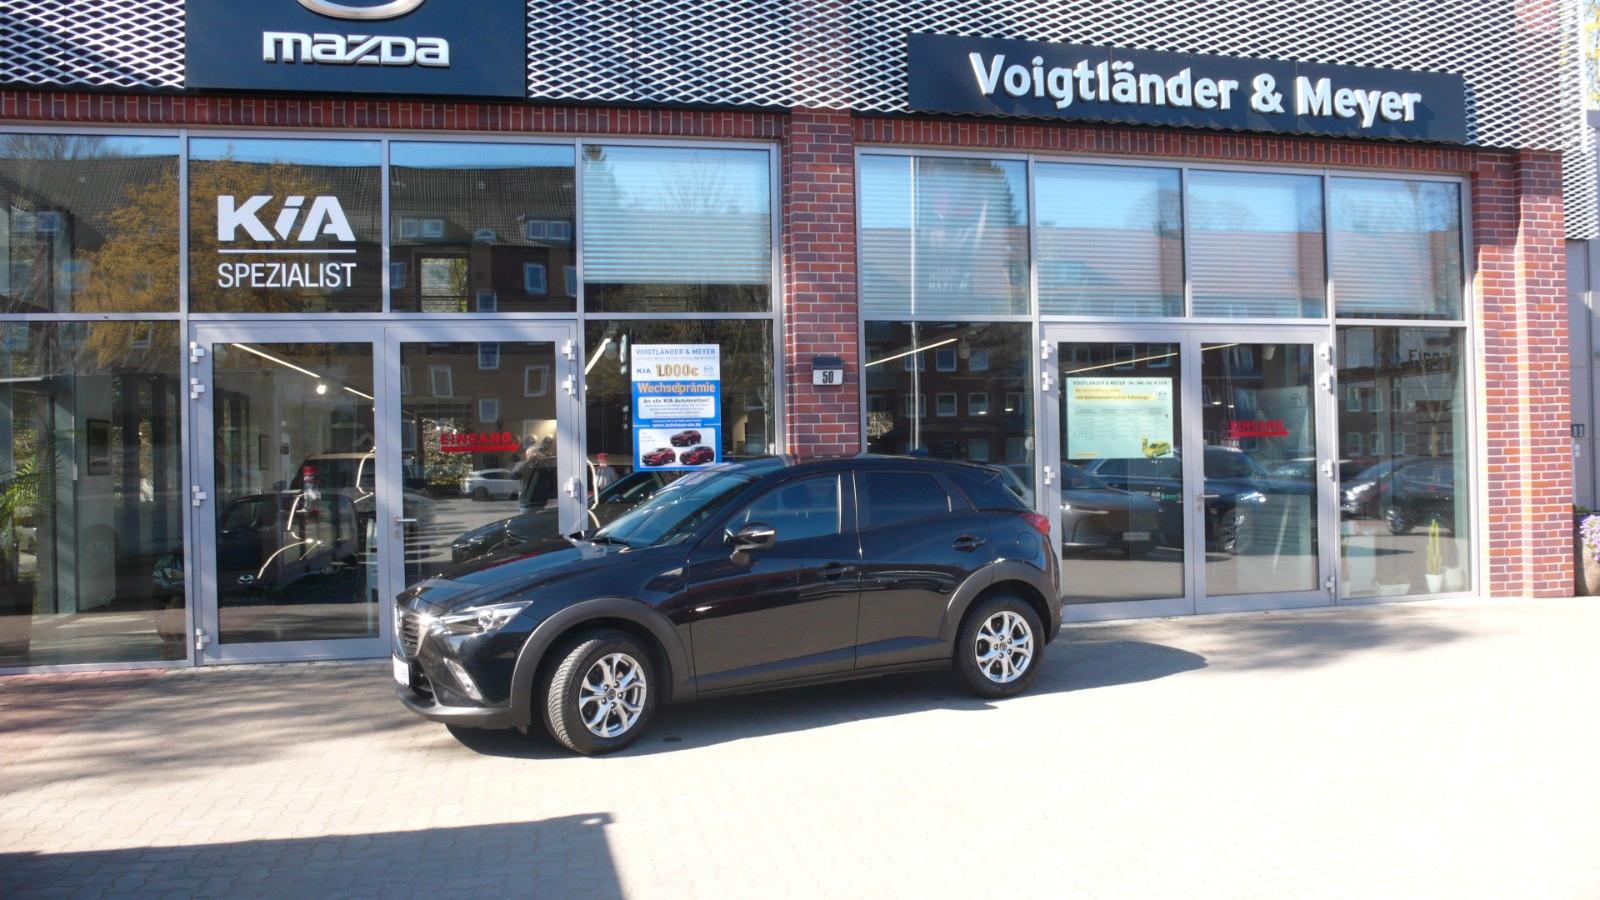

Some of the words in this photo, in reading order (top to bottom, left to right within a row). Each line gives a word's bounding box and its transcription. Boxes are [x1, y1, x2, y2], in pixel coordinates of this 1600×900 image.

[969, 52, 1239, 110] Voigtländer
[1251, 73, 1285, 114] &
[1297, 75, 1422, 128] Meyer
[217, 195, 356, 241] KIA
[217, 263, 357, 288] SPEZIALIST
[822, 371, 834, 383] 50
[637, 383, 716, 395] Wechselprämie
[440, 432, 512, 444] EINGANG
